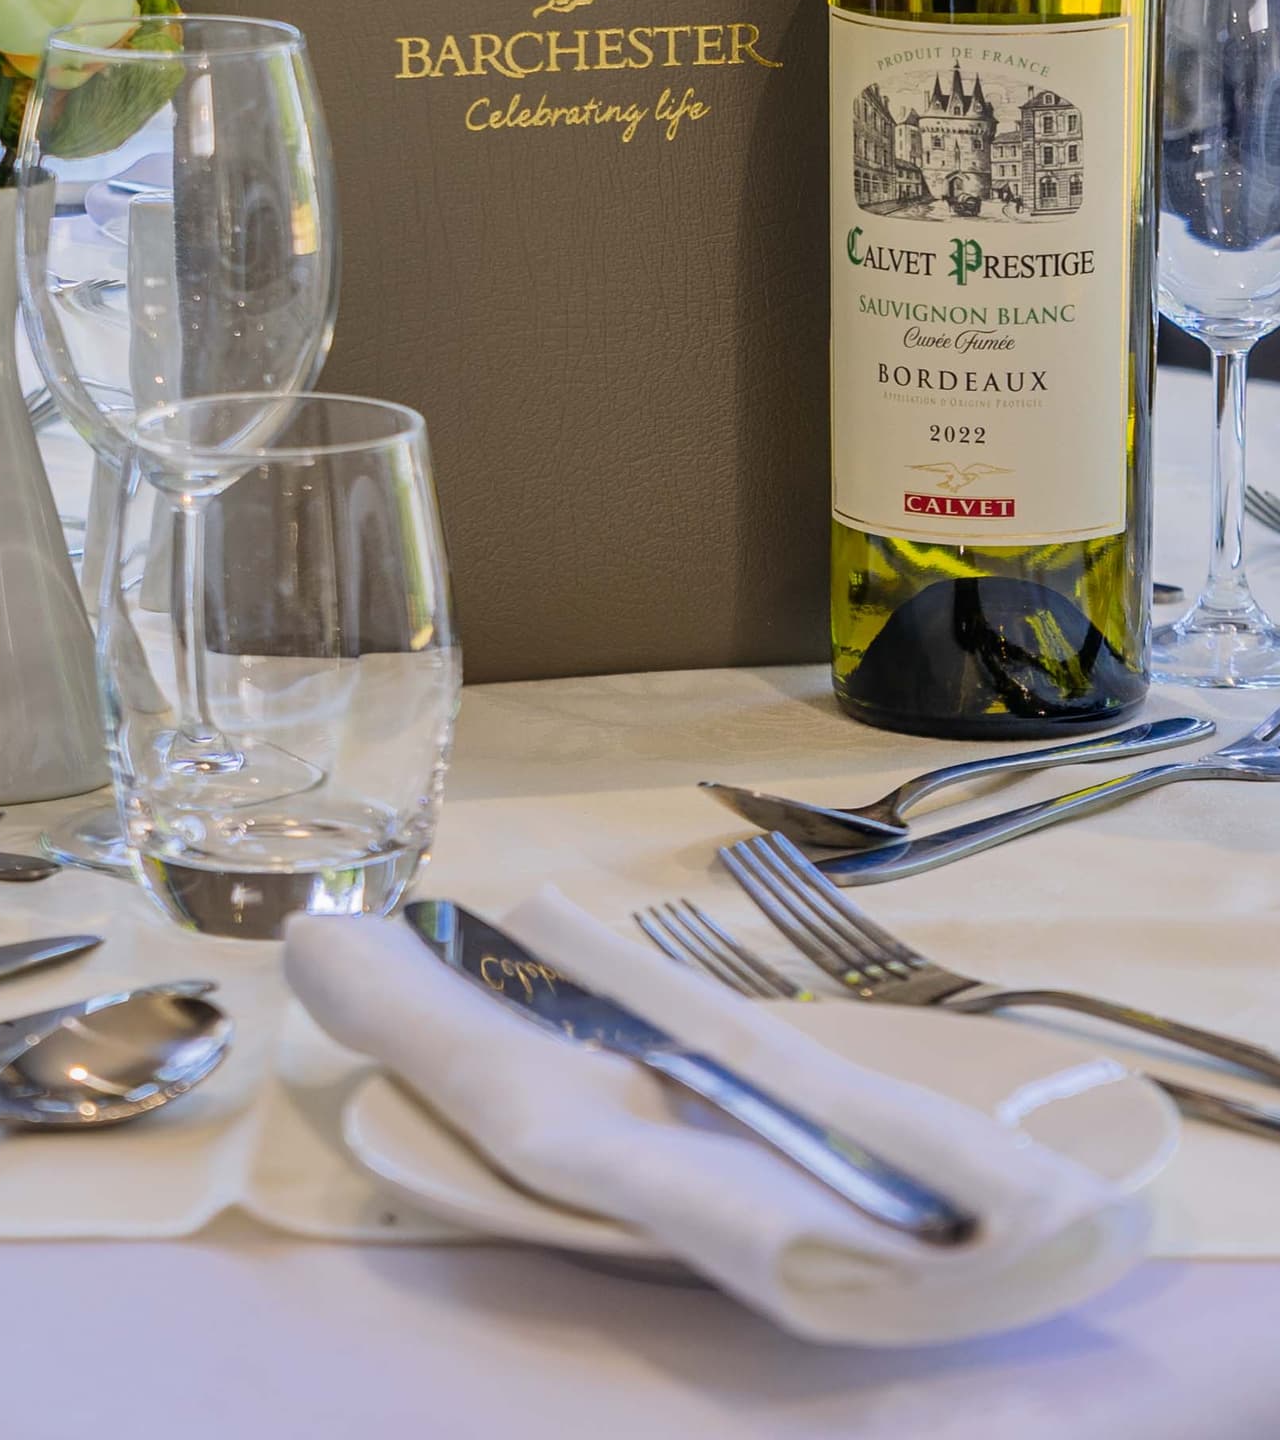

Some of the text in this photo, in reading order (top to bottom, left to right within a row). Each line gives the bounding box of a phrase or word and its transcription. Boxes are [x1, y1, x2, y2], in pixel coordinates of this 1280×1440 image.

[395, 23, 783, 80] BARCHESTER
[877, 47, 1051, 77] PRODUIT DE FRANCE
[465, 88, 712, 143] Celebrating life
[847, 226, 1096, 286] CALVET PRESTIGE
[859, 294, 1076, 325] SAUVIGNON BLANC
[903, 326, 1016, 354] Cuvée Fumée
[878, 362, 1048, 392] BORDEAUX
[929, 424, 987, 444] 2022
[906, 495, 1013, 516] CALVET
